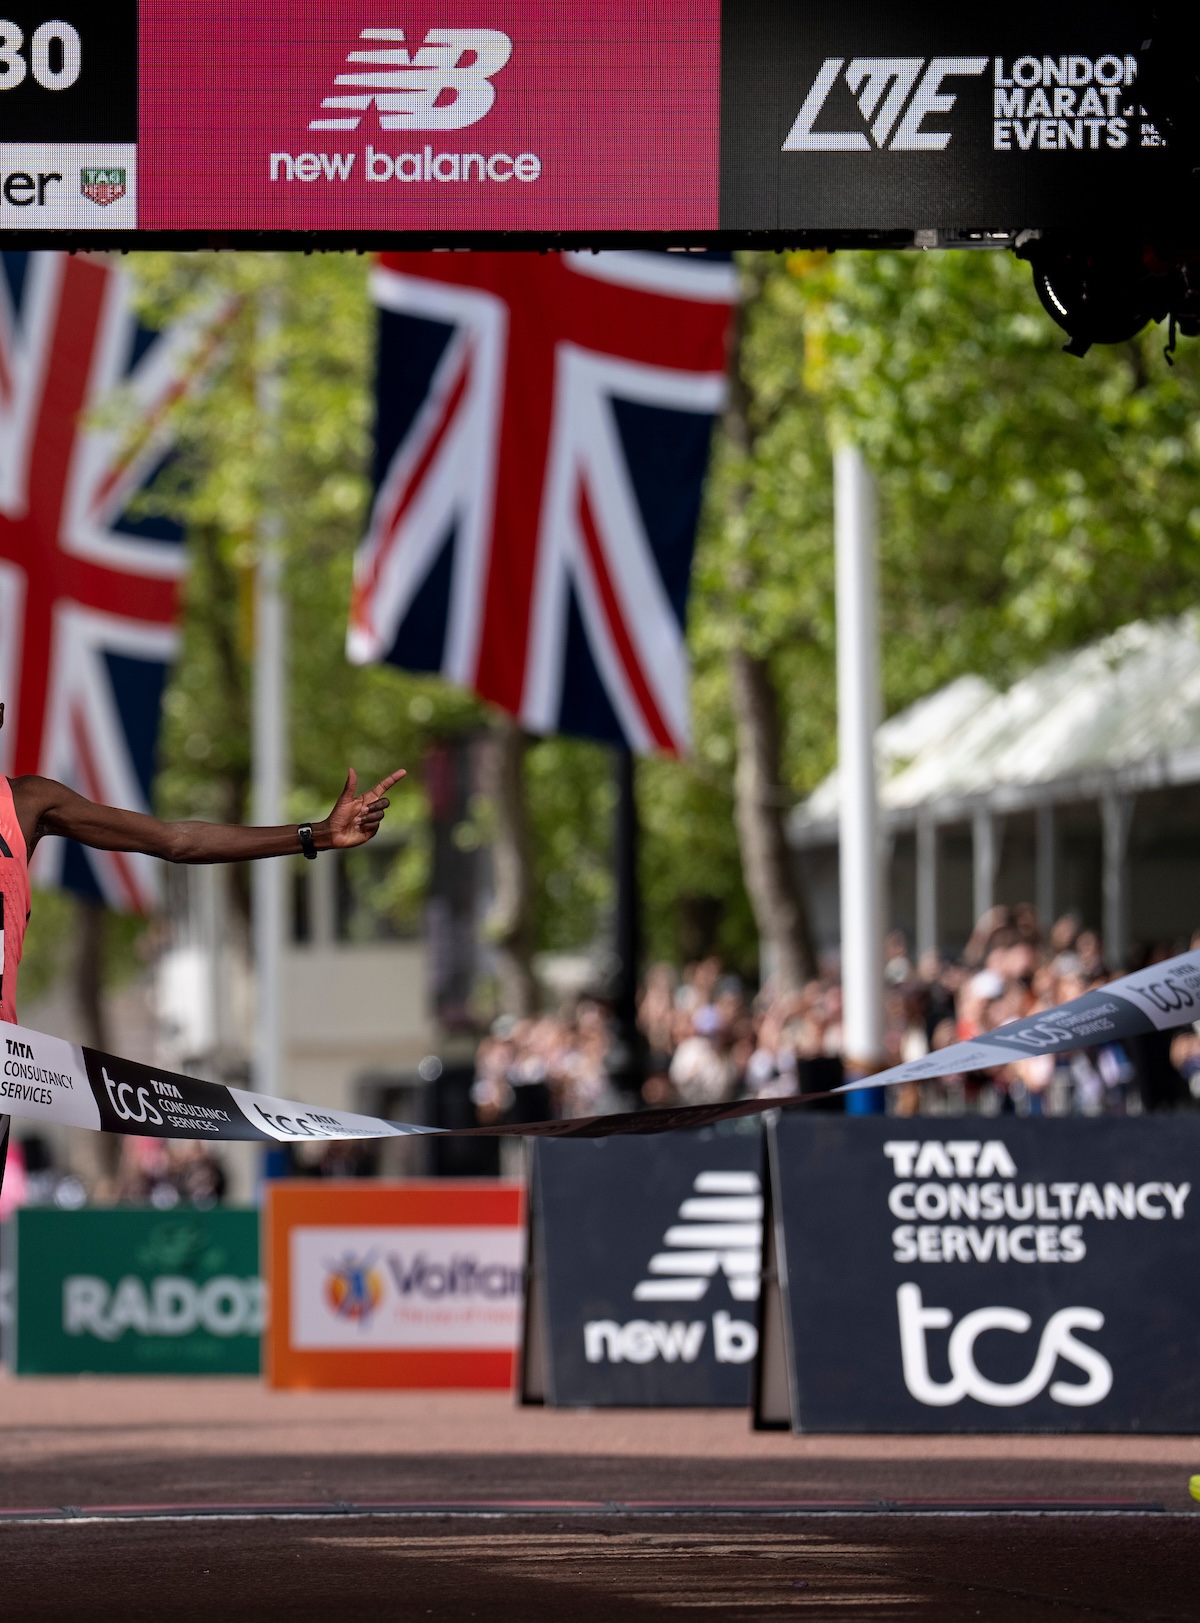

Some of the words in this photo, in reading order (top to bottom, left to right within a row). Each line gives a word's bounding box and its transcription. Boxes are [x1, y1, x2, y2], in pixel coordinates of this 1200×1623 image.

[993, 87, 1148, 118] MARAT
[993, 117, 1129, 150] EVENTS
[85, 171, 120, 184] TAG
[269, 151, 356, 182] new
[365, 145, 542, 182] balance
[6, 1039, 34, 1060] TATA
[994, 1023, 1073, 1048] tcs
[3, 1060, 74, 1090] CONSULTANCY
[150, 1080, 183, 1099] TATA
[0, 1081, 52, 1104] SERVICES
[101, 1066, 164, 1126] tcs
[158, 1099, 232, 1122] CONSULTANCY
[167, 1115, 220, 1132] SERVICES
[305, 1113, 342, 1125] TATA
[883, 1141, 1017, 1177] TATA
[888, 1182, 1191, 1220] CONSULTANCY
[892, 1225, 1086, 1263] SERVICES
[584, 1318, 706, 1363] new
[897, 1282, 1114, 1406] tcs
